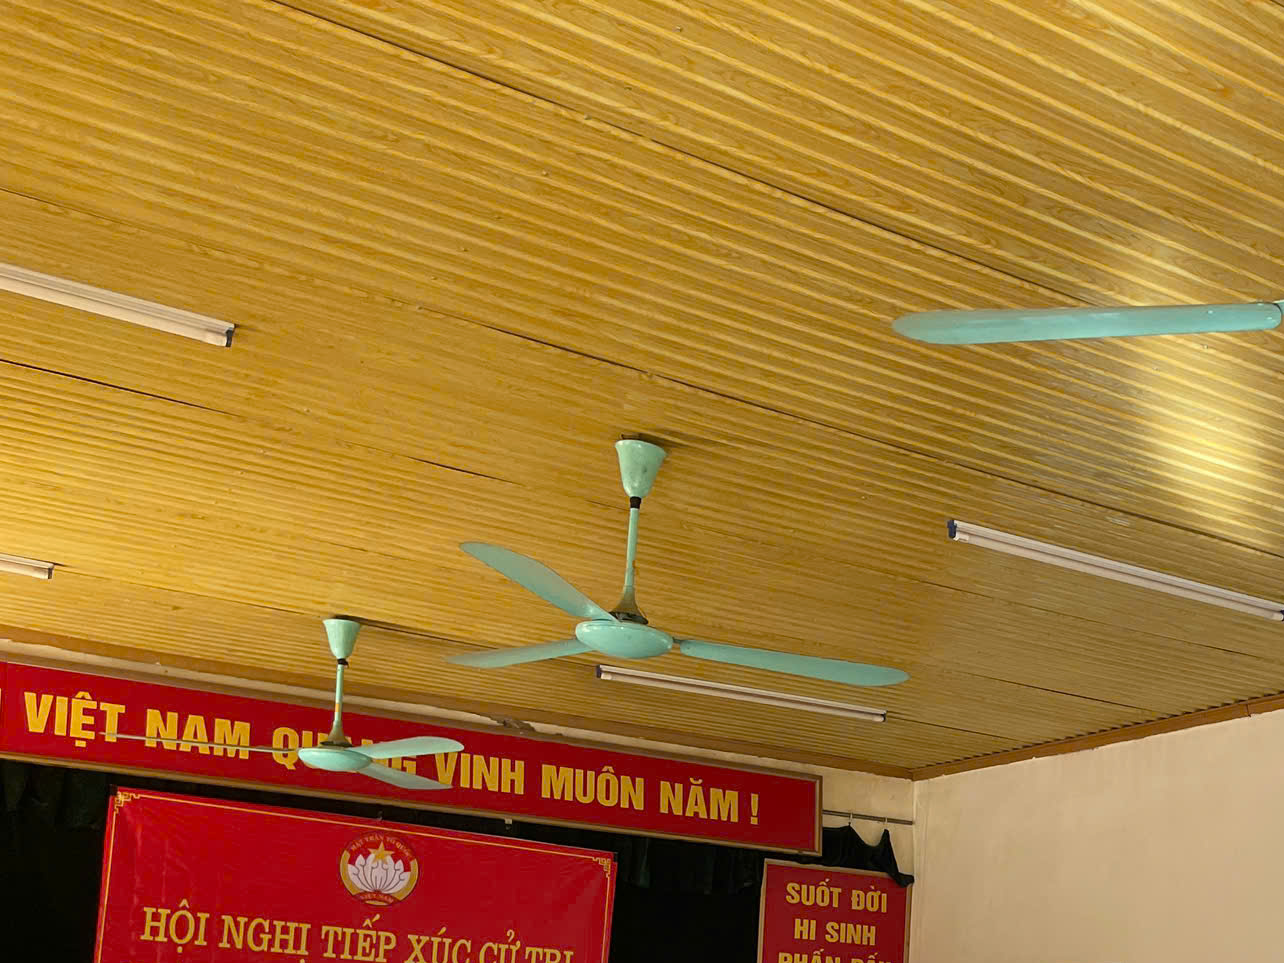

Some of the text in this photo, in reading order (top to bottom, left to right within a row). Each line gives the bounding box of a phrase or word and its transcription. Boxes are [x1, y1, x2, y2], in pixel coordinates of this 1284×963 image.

[24, 691, 125, 747] VIỆT
[145, 709, 250, 759] NAM
[436, 752, 524, 795] VINH
[541, 765, 644, 810] MUÔN
[660, 778, 739, 822] NĂM
[785, 878, 887, 913] SUỐT ĐỜI
[140, 898, 210, 954] HỘI
[321, 914, 397, 963] TIẾP
[794, 918, 876, 945] HI SINH
